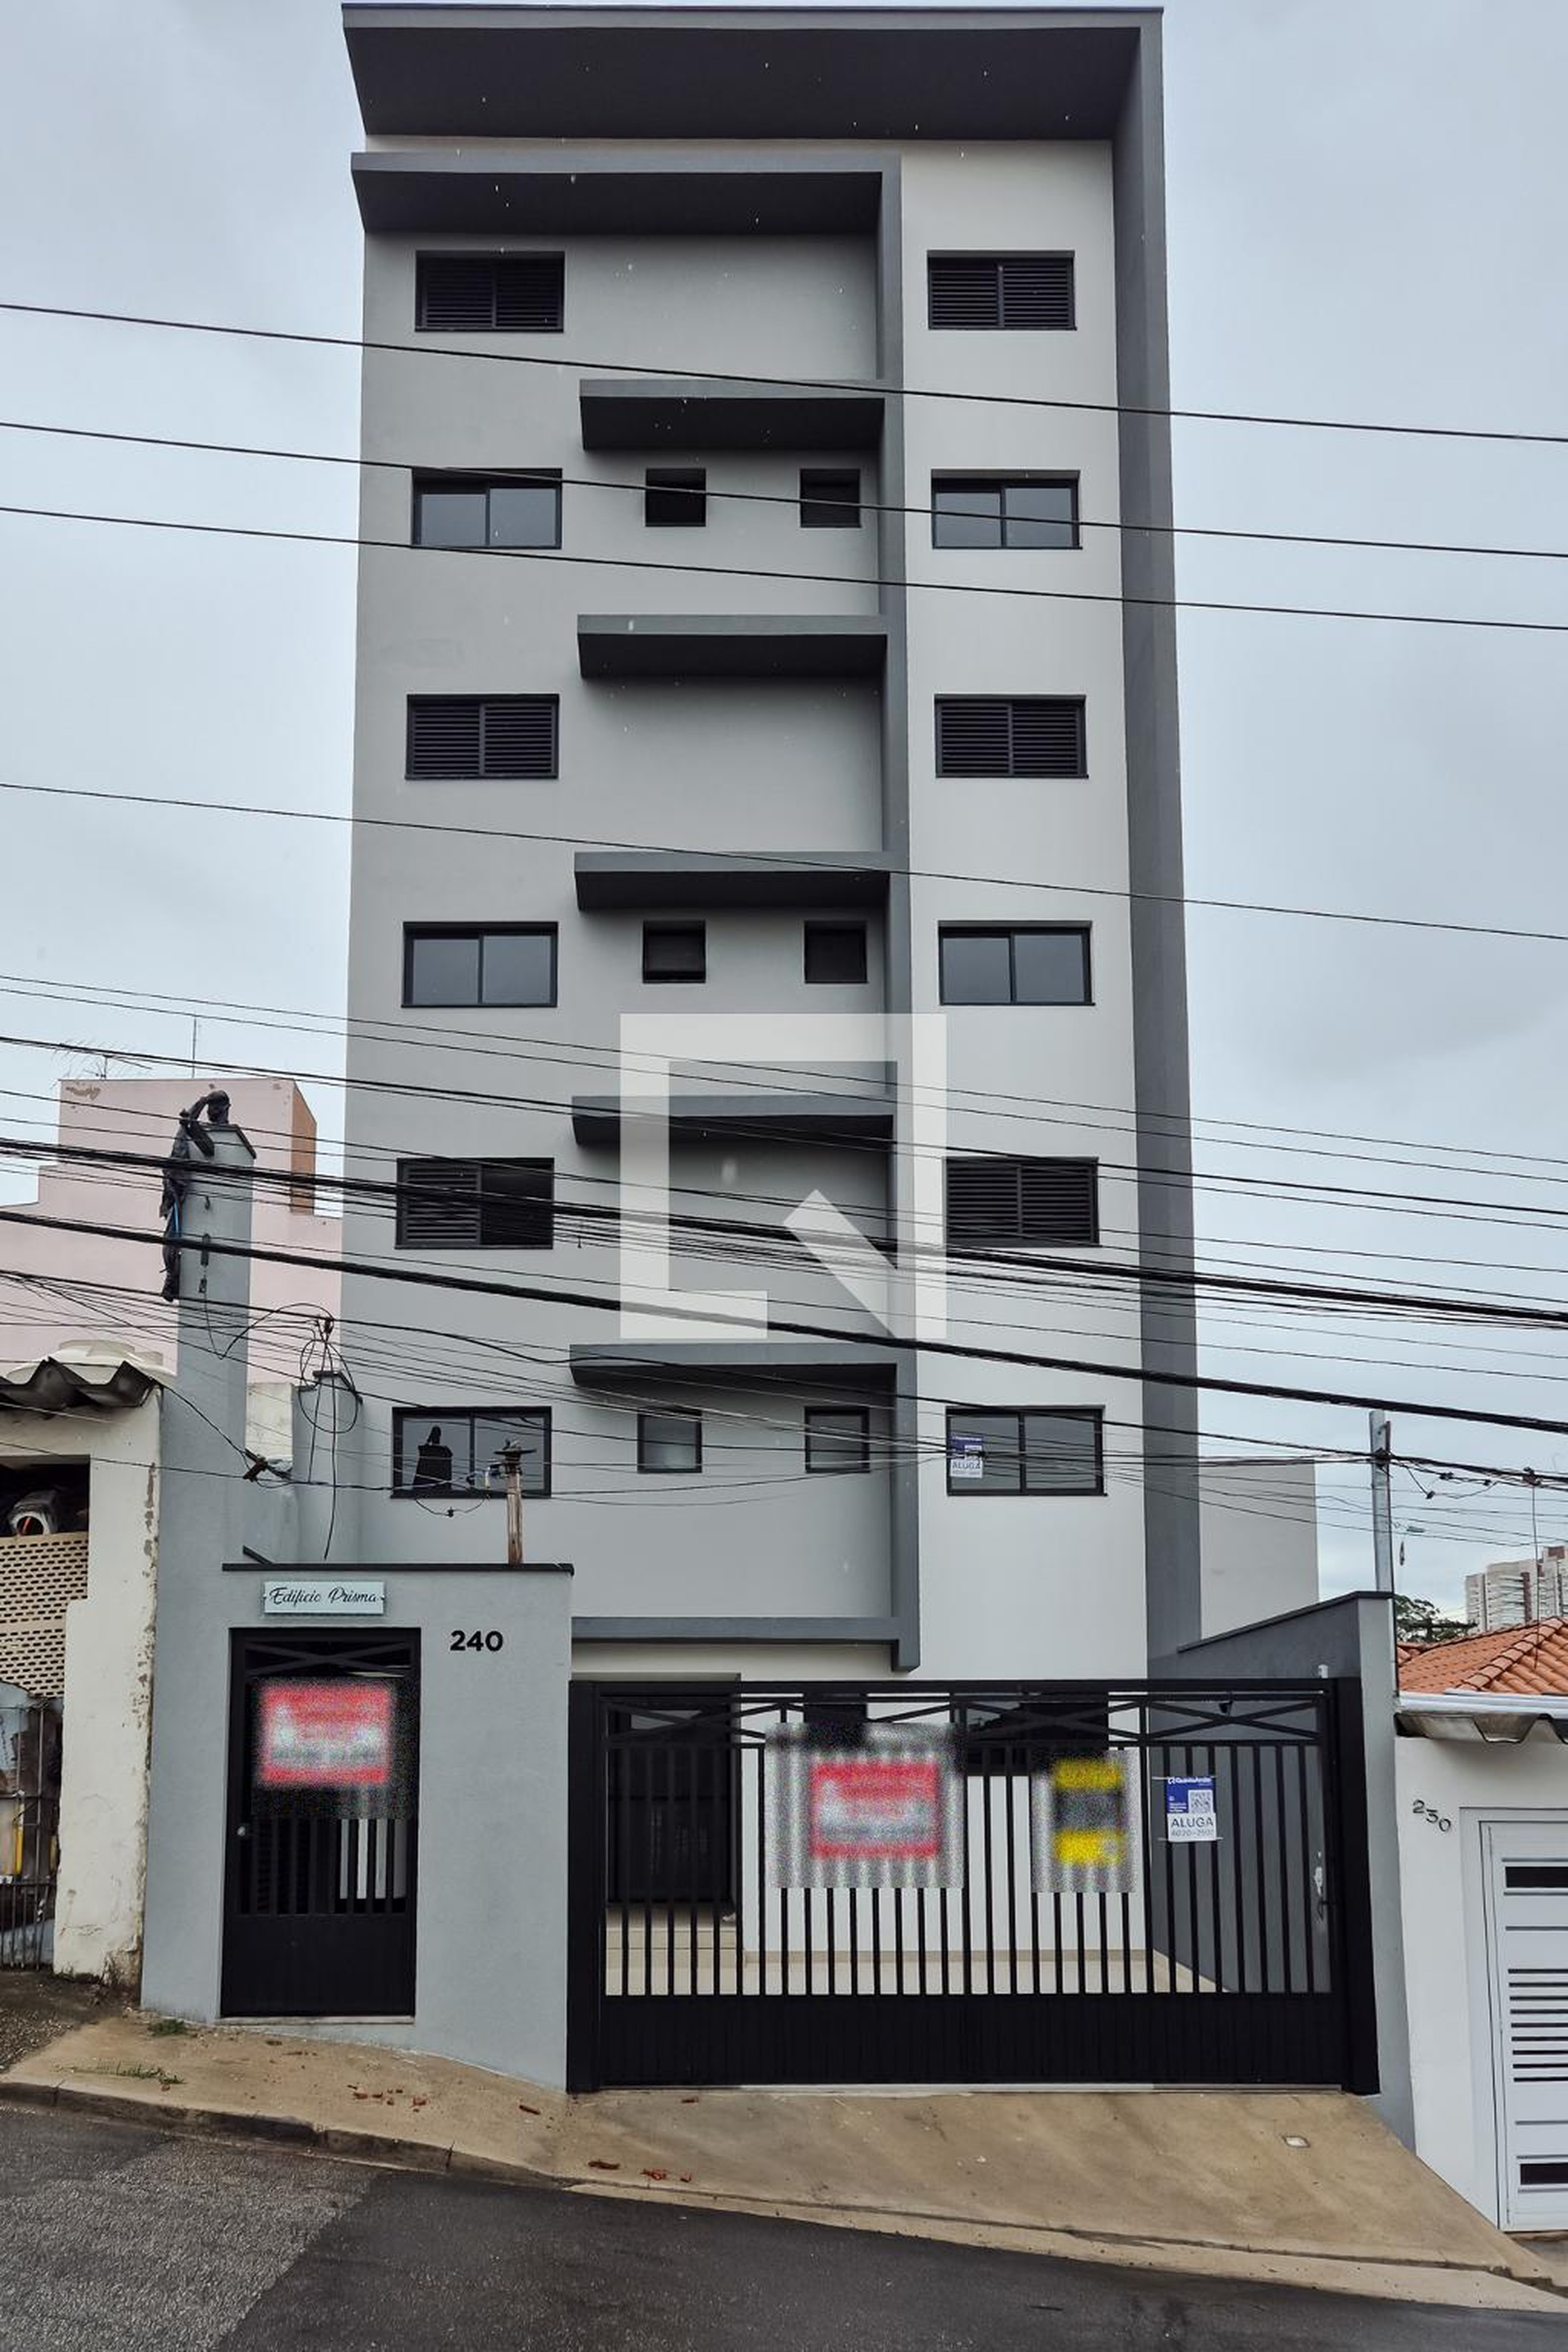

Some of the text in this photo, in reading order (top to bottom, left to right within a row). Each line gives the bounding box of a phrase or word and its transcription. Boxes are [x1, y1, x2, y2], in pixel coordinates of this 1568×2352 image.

[328, 1587, 376, 1603] Prisma
[450, 1630, 503, 1651] 240
[1172, 1817, 1213, 1827] ALUGA
